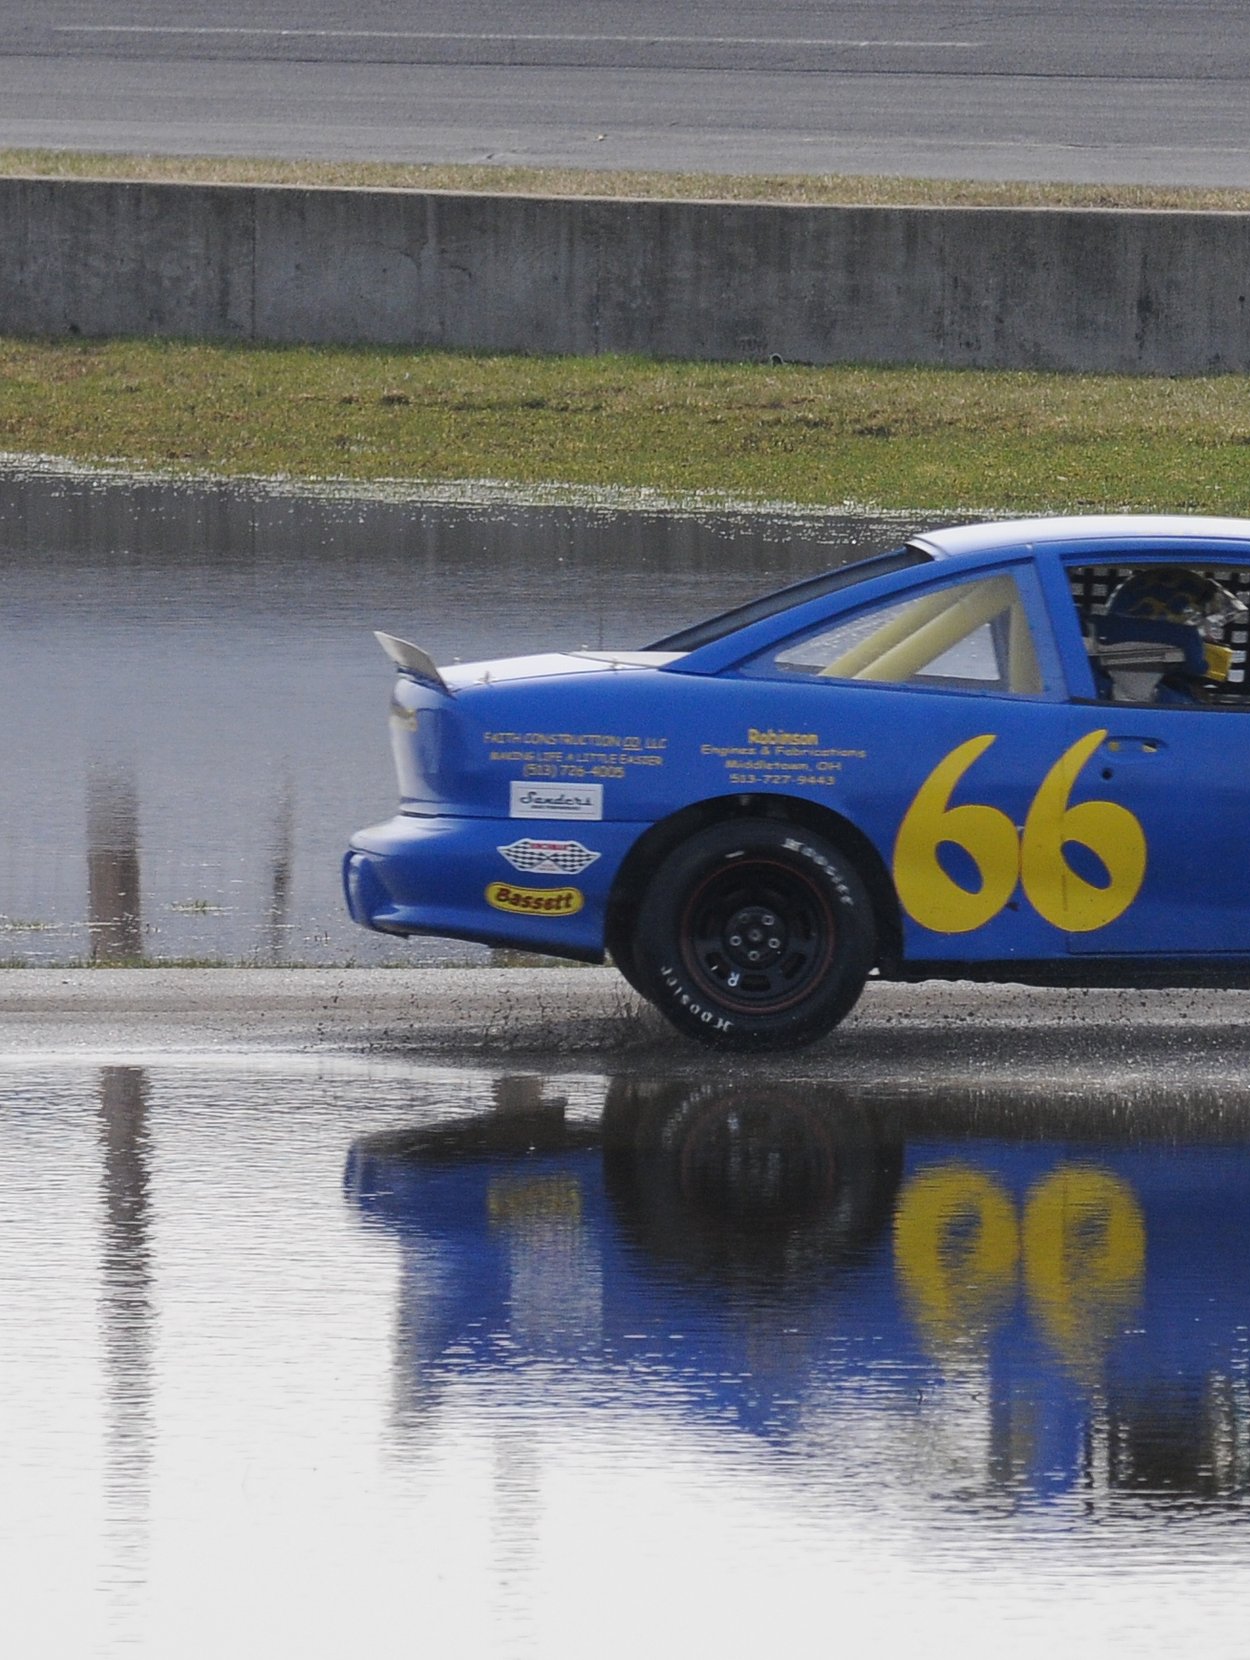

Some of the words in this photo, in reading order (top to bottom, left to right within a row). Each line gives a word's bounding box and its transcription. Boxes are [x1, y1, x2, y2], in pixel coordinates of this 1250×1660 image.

[524, 733, 620, 746] CONSTRUCTION
[747, 728, 819, 745] Robinson
[537, 752, 563, 762] LIFE
[576, 753, 617, 764] LITTLE
[700, 744, 757, 757] Engines
[760, 746, 771, 756] &
[775, 746, 868, 759] Fabrications
[816, 761, 843, 771] OH
[520, 791, 594, 806] Sanders
[893, 729, 1147, 934] 66
[495, 887, 574, 910] Bassett
